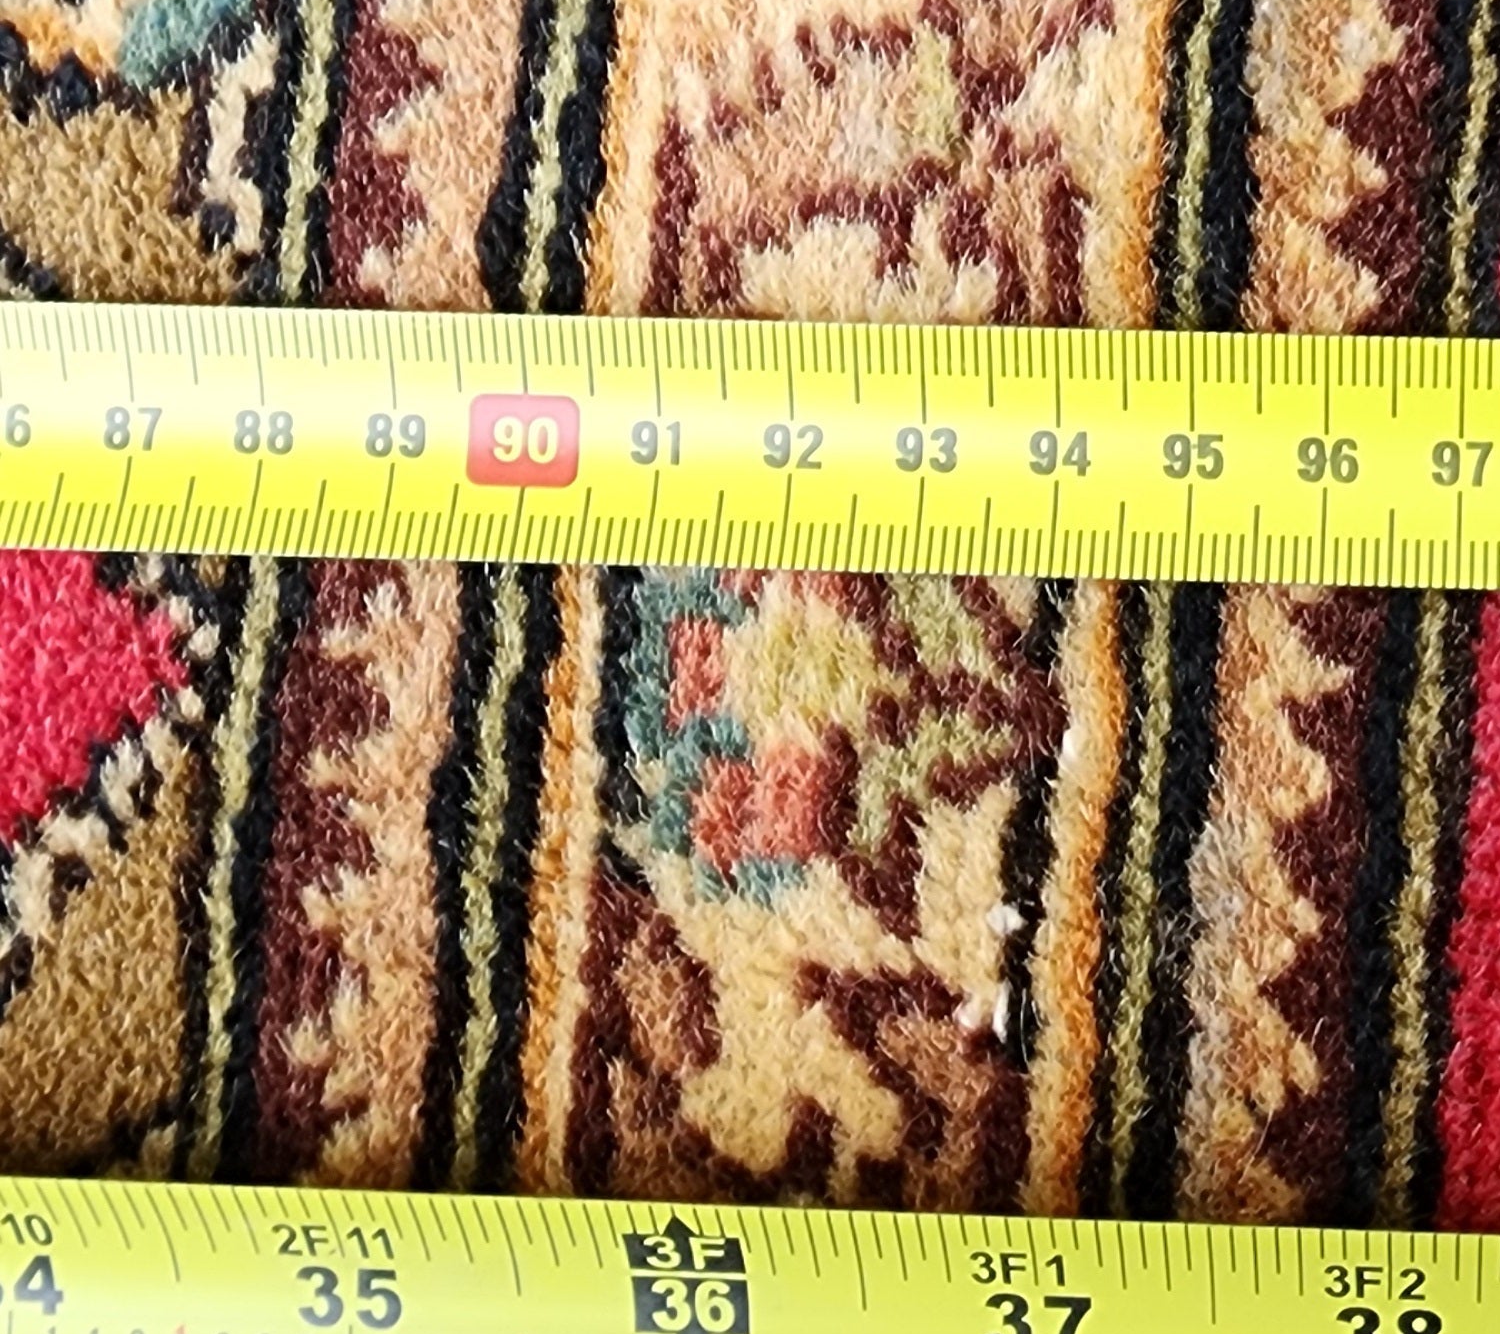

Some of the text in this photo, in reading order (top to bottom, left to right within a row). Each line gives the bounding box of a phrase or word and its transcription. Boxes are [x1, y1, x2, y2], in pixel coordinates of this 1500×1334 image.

[5, 404, 30, 446] 6
[103, 406, 162, 451] 87
[234, 409, 294, 455] 88
[364, 412, 426, 458] 89
[492, 416, 558, 463] 90
[630, 421, 680, 465] 91
[763, 423, 822, 470] 92
[895, 426, 958, 472] 93
[1029, 430, 1091, 477] 94
[1163, 433, 1223, 480] 95
[1296, 437, 1359, 483] 96
[1431, 440, 1494, 487] 97
[0, 1255, 63, 1315] 4
[295, 1266, 402, 1328] 35
[651, 1278, 735, 1333] 36
[1, 1213, 53, 1246] 10
[271, 1223, 328, 1255] 2F
[346, 1227, 394, 1259] 11
[642, 1235, 725, 1269] 3F
[969, 1251, 1028, 1284] 3F
[1045, 1254, 1066, 1287] 1
[1324, 1265, 1384, 1298] 3F
[1399, 1268, 1426, 1300] 2
